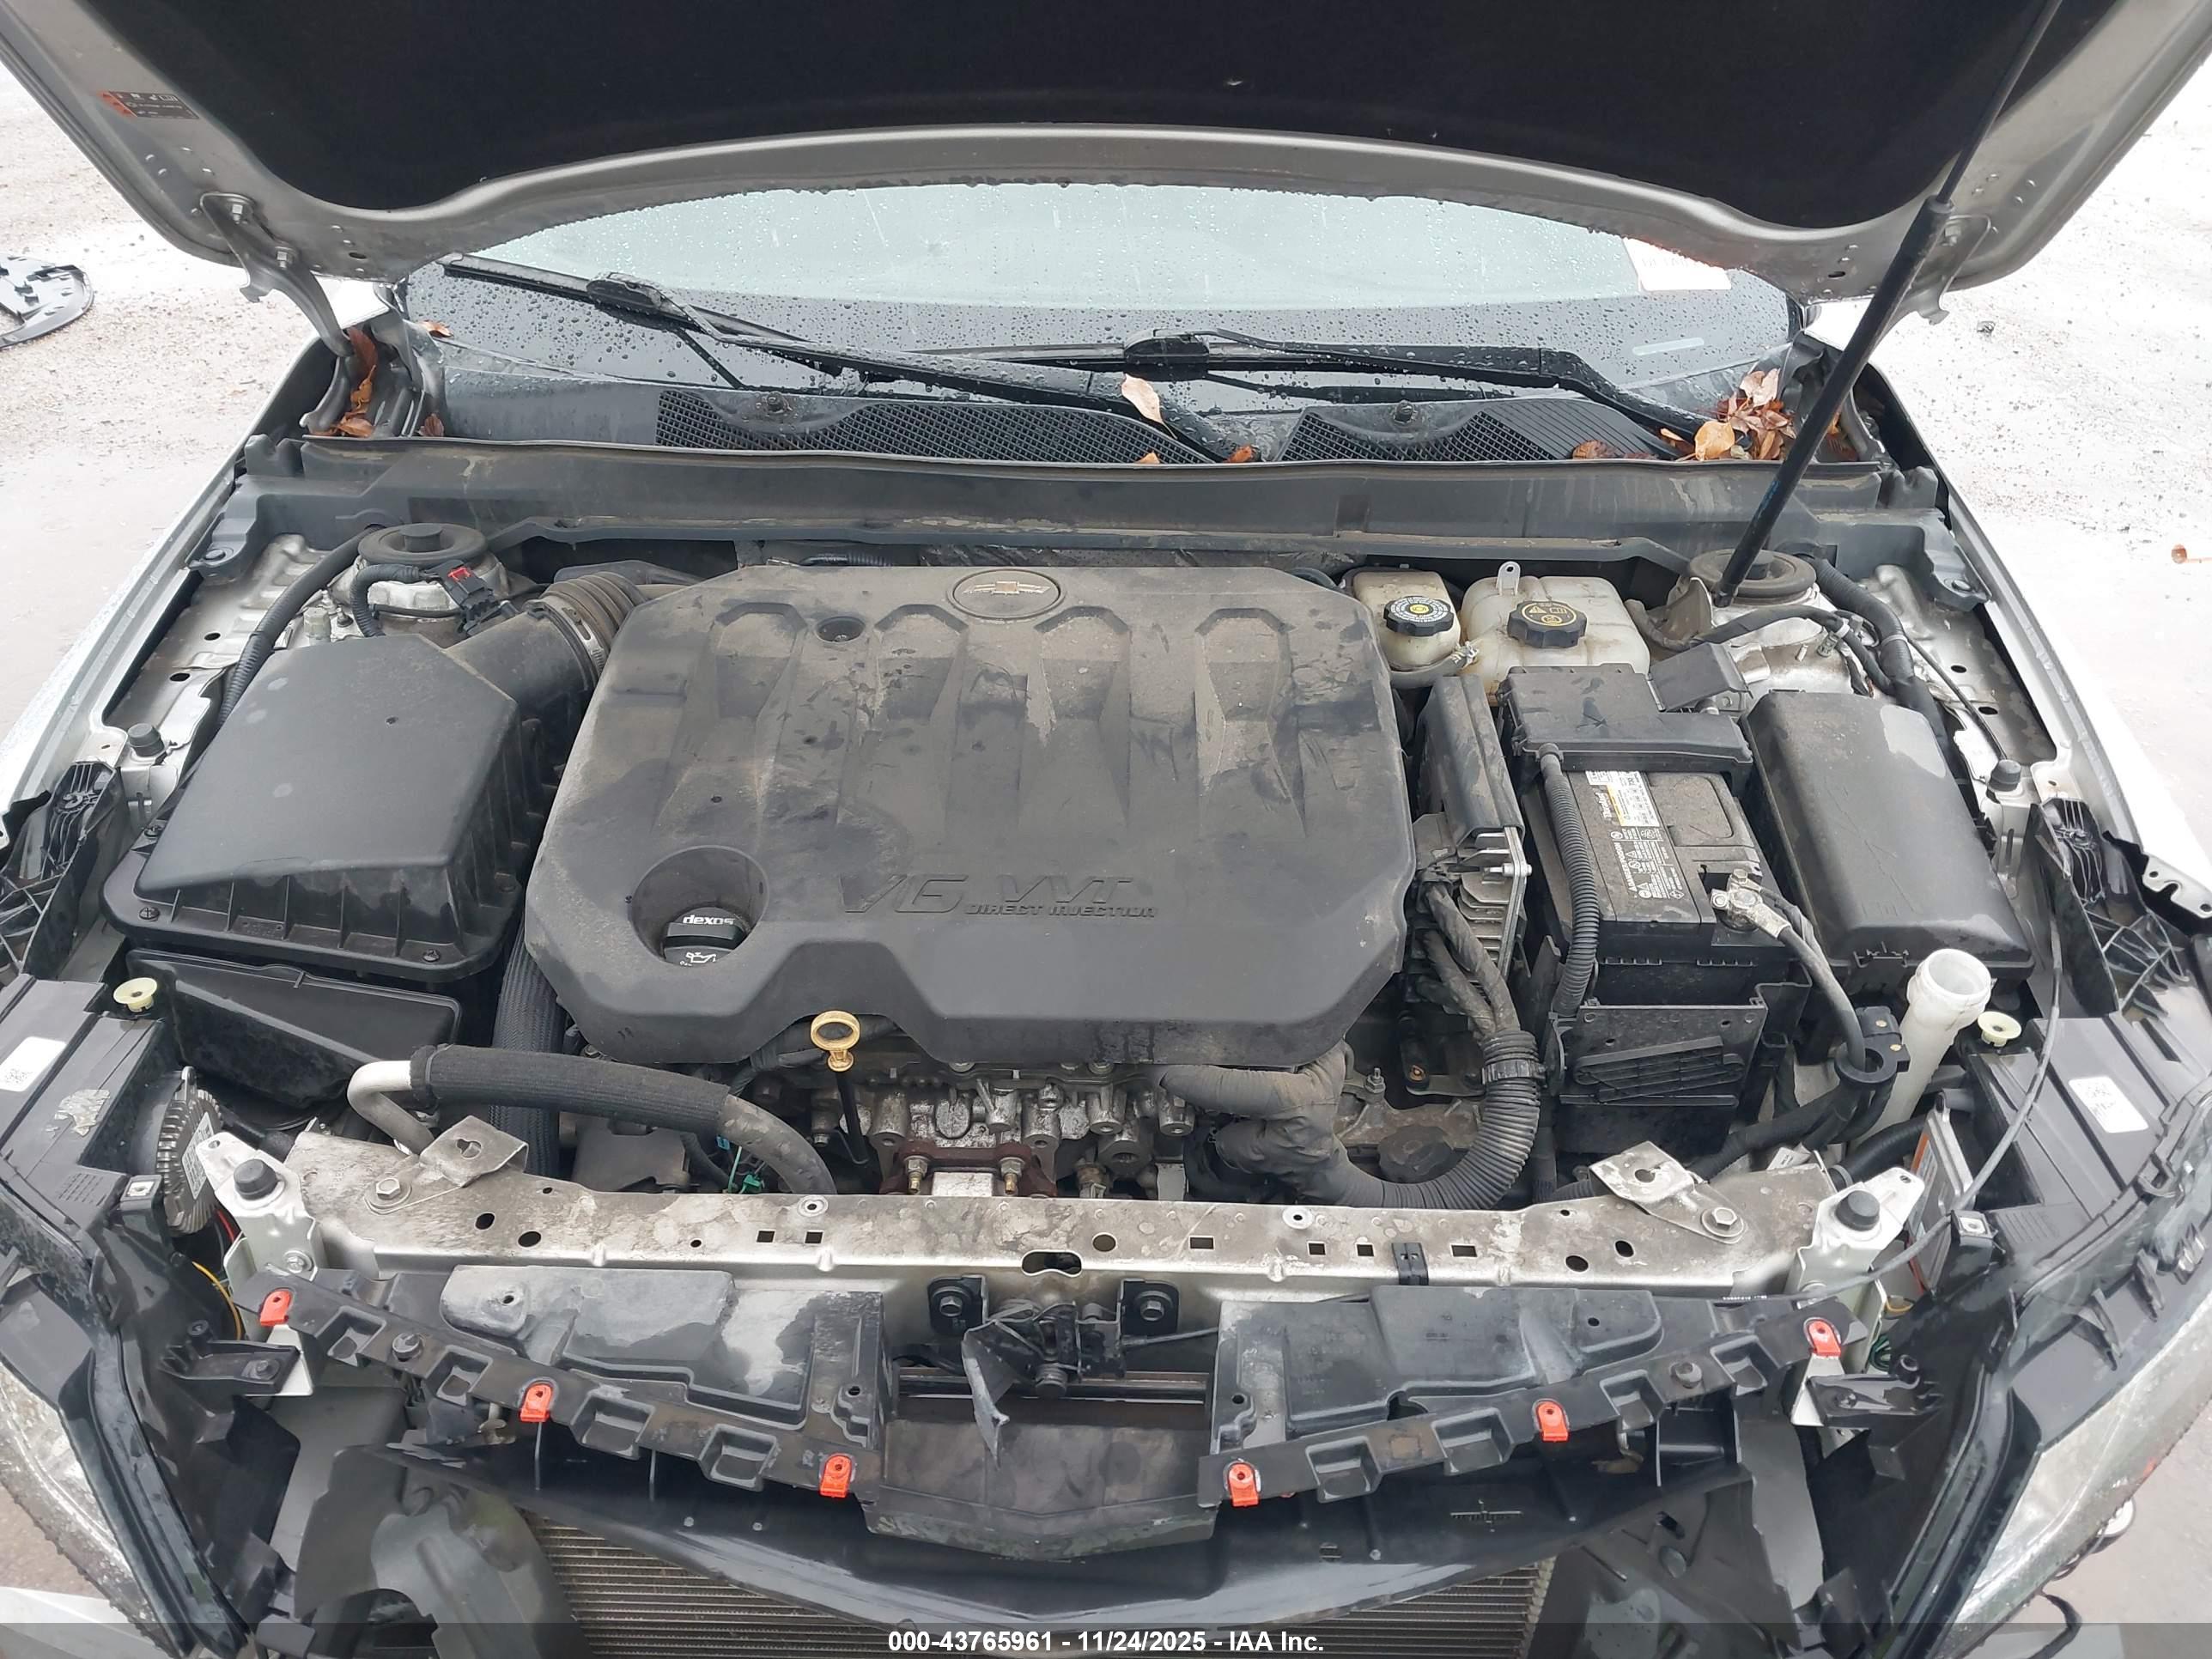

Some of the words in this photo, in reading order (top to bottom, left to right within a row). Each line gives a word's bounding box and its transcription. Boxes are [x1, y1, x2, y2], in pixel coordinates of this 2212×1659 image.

[839, 874, 969, 914] V6
[995, 874, 1134, 904] VVT
[964, 904, 1044, 915] DIRECT
